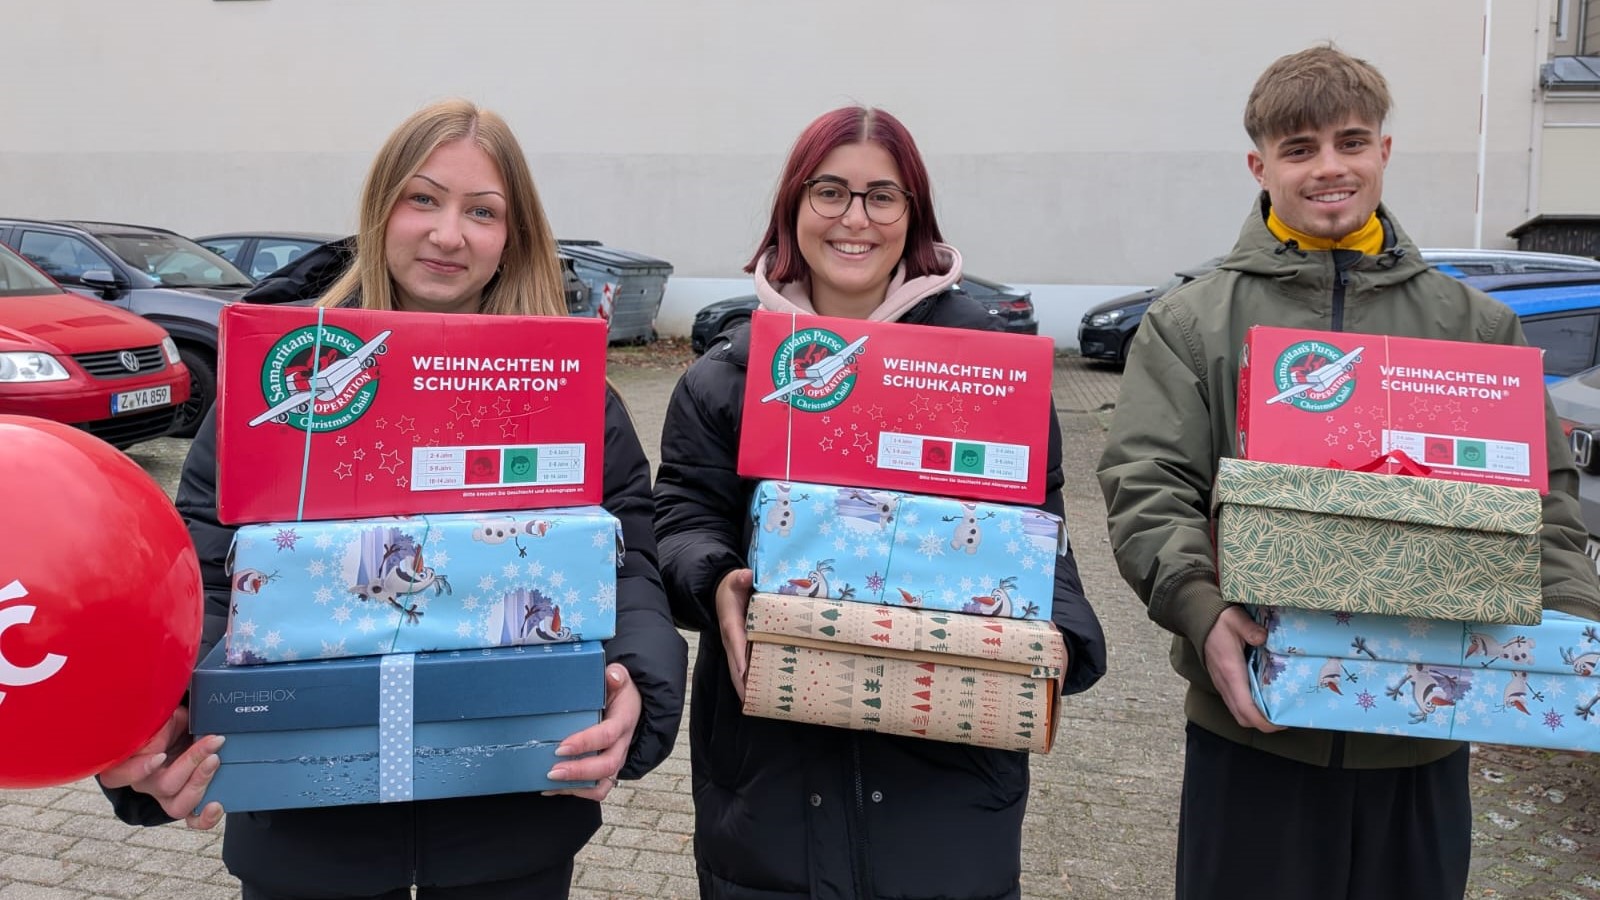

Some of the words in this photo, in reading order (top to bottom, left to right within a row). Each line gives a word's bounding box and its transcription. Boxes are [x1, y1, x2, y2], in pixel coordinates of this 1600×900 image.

[813, 330, 842, 351] Purse
[1311, 342, 1340, 360] Purse
[269, 331, 315, 402] Samaritan's
[412, 356, 555, 373] WEIHNACHTEN
[560, 359, 580, 373] IM
[883, 357, 1004, 381] WEIHNACHTEN
[1009, 369, 1027, 383] IM
[807, 367, 852, 397] OPERATION
[1309, 373, 1351, 400] OPERATION
[1379, 365, 1498, 386] WEIHNACHTEN
[1502, 375, 1521, 388] IM
[121, 394, 129, 409] Z
[135, 391, 149, 406] YA
[150, 388, 167, 404] 859
[313, 371, 372, 413] OPERATION
[350, 391, 371, 415] Child
[796, 399, 837, 410] Christmas
[834, 382, 850, 401] Child
[207, 689, 296, 705] AMPHIBIOX
[234, 705, 269, 714] GEOX
